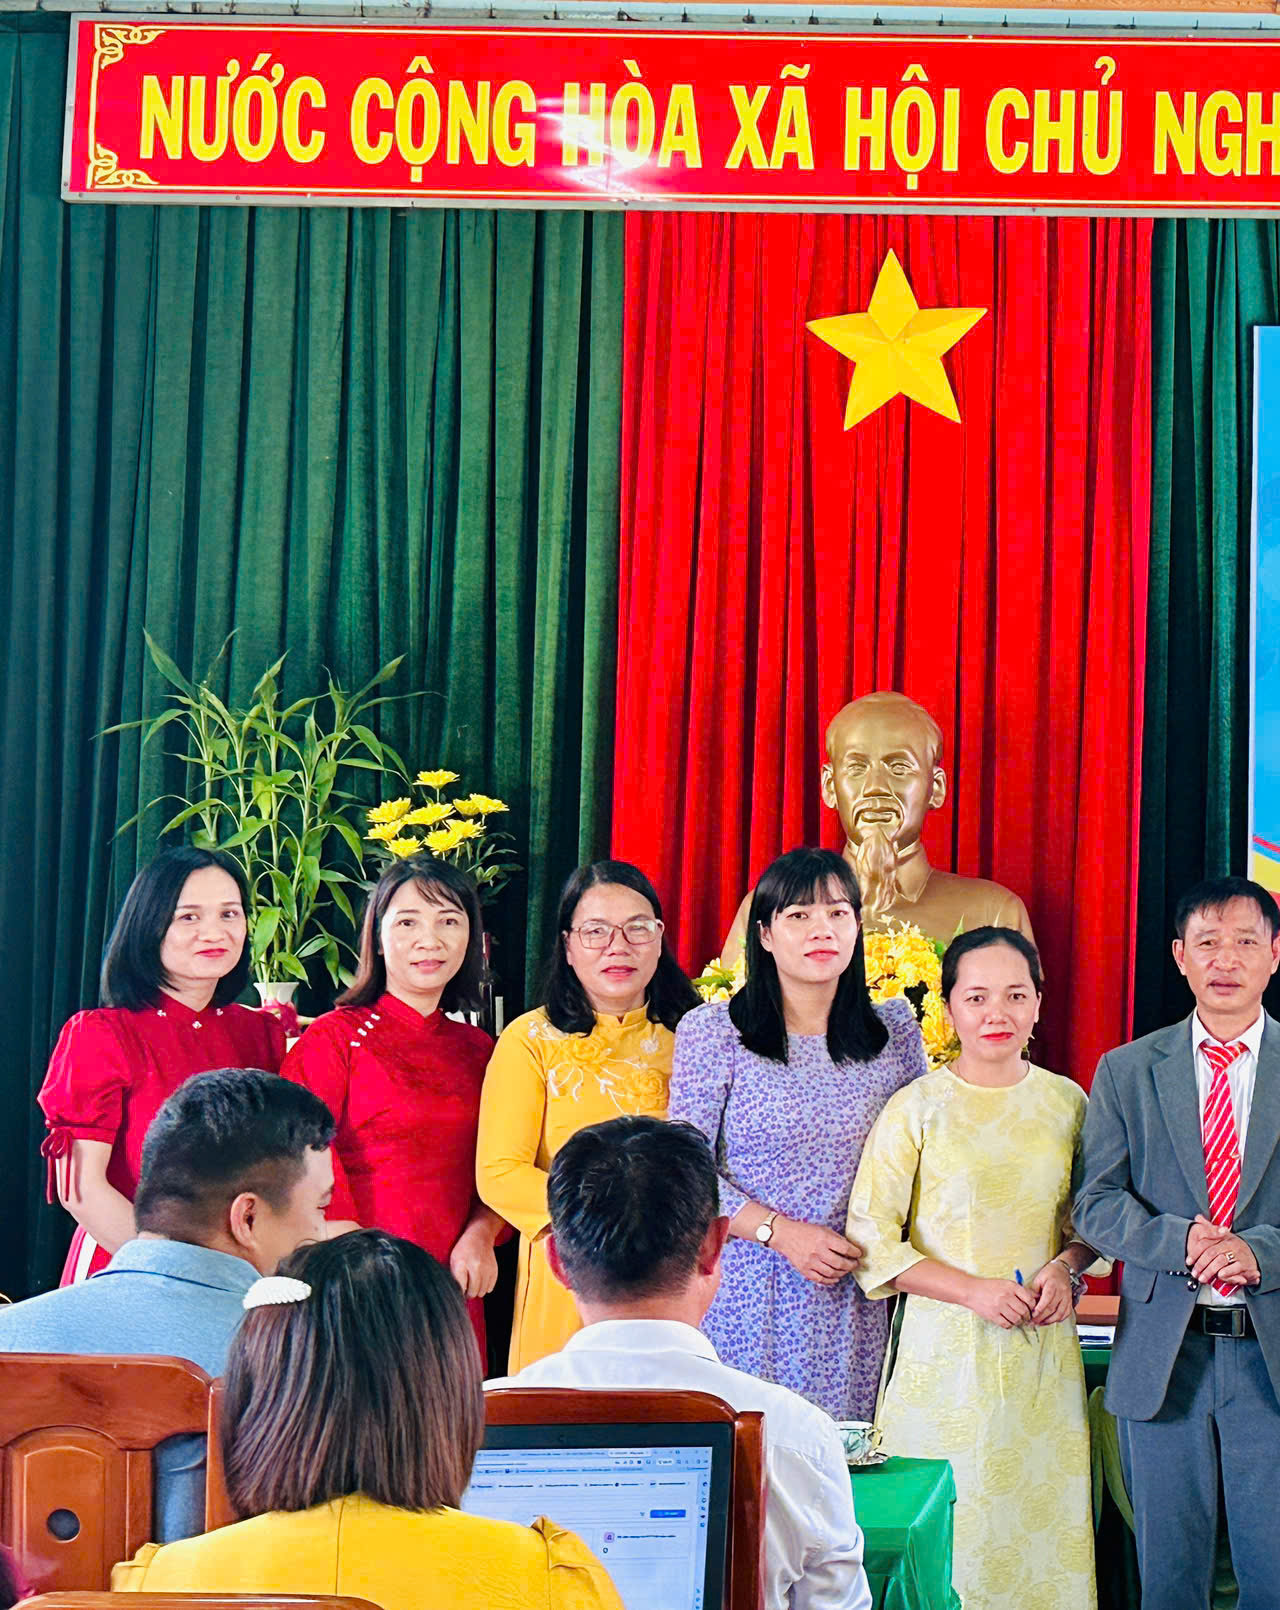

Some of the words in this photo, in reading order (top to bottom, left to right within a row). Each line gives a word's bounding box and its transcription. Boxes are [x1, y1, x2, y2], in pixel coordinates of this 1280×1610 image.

[140, 54, 326, 162] NƯỚC
[351, 56, 536, 183] CỘNG
[561, 60, 702, 168] HÒA
[726, 64, 814, 169] XÃ
[844, 64, 960, 189] HỘI
[986, 56, 1122, 175] CHỦ
